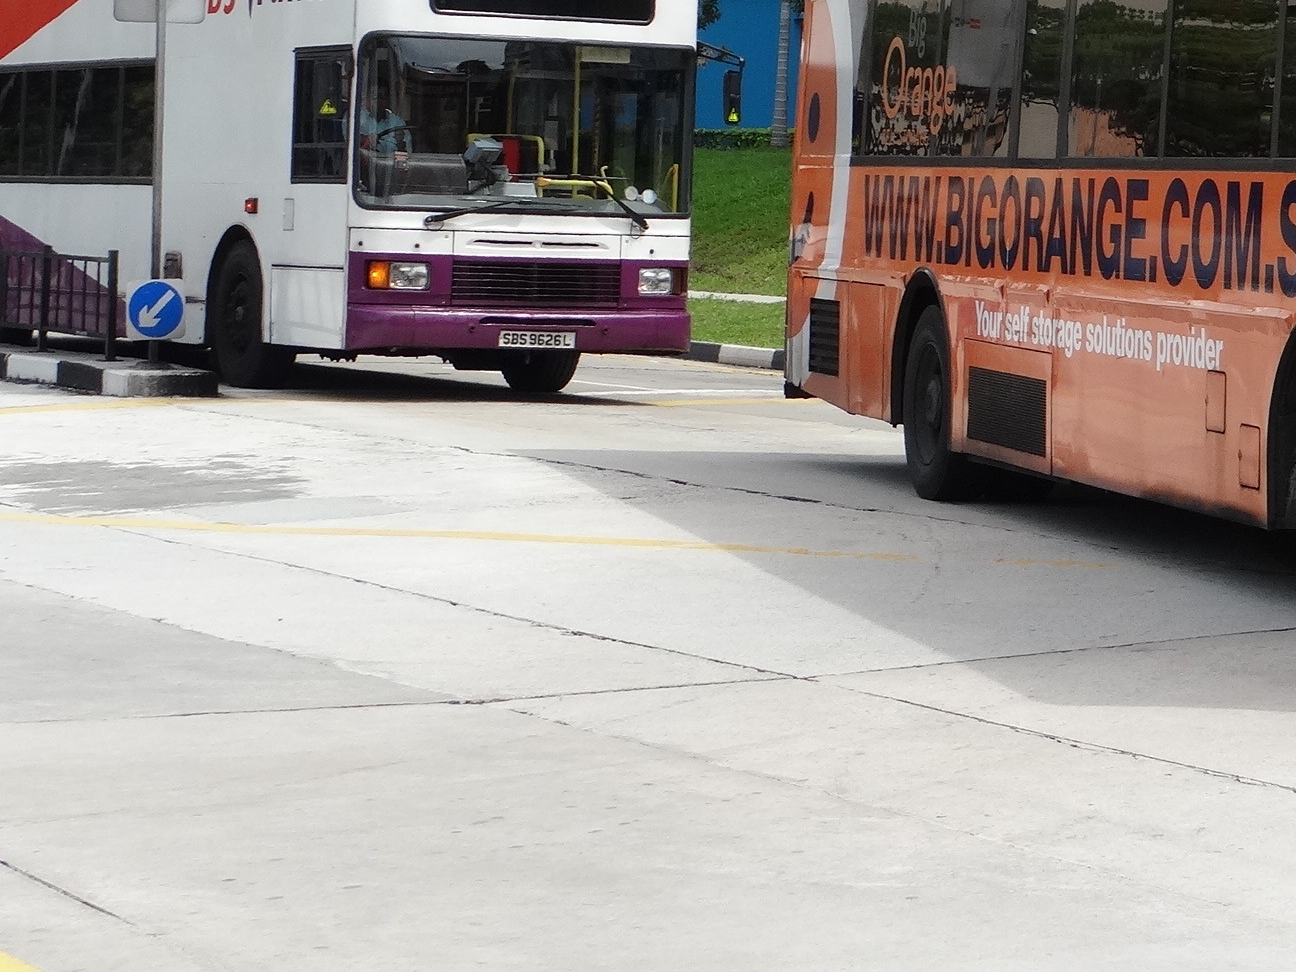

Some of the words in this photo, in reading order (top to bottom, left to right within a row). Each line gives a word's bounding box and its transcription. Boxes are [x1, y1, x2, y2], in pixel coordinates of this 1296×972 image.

[909, 7, 927, 58] Big
[884, 36, 958, 135] Orange
[974, 300, 1003, 340] Your
[1005, 306, 1030, 343] self
[1032, 309, 1082, 359] storage
[1086, 315, 1152, 361] solutions
[1157, 327, 1224, 371] provider
